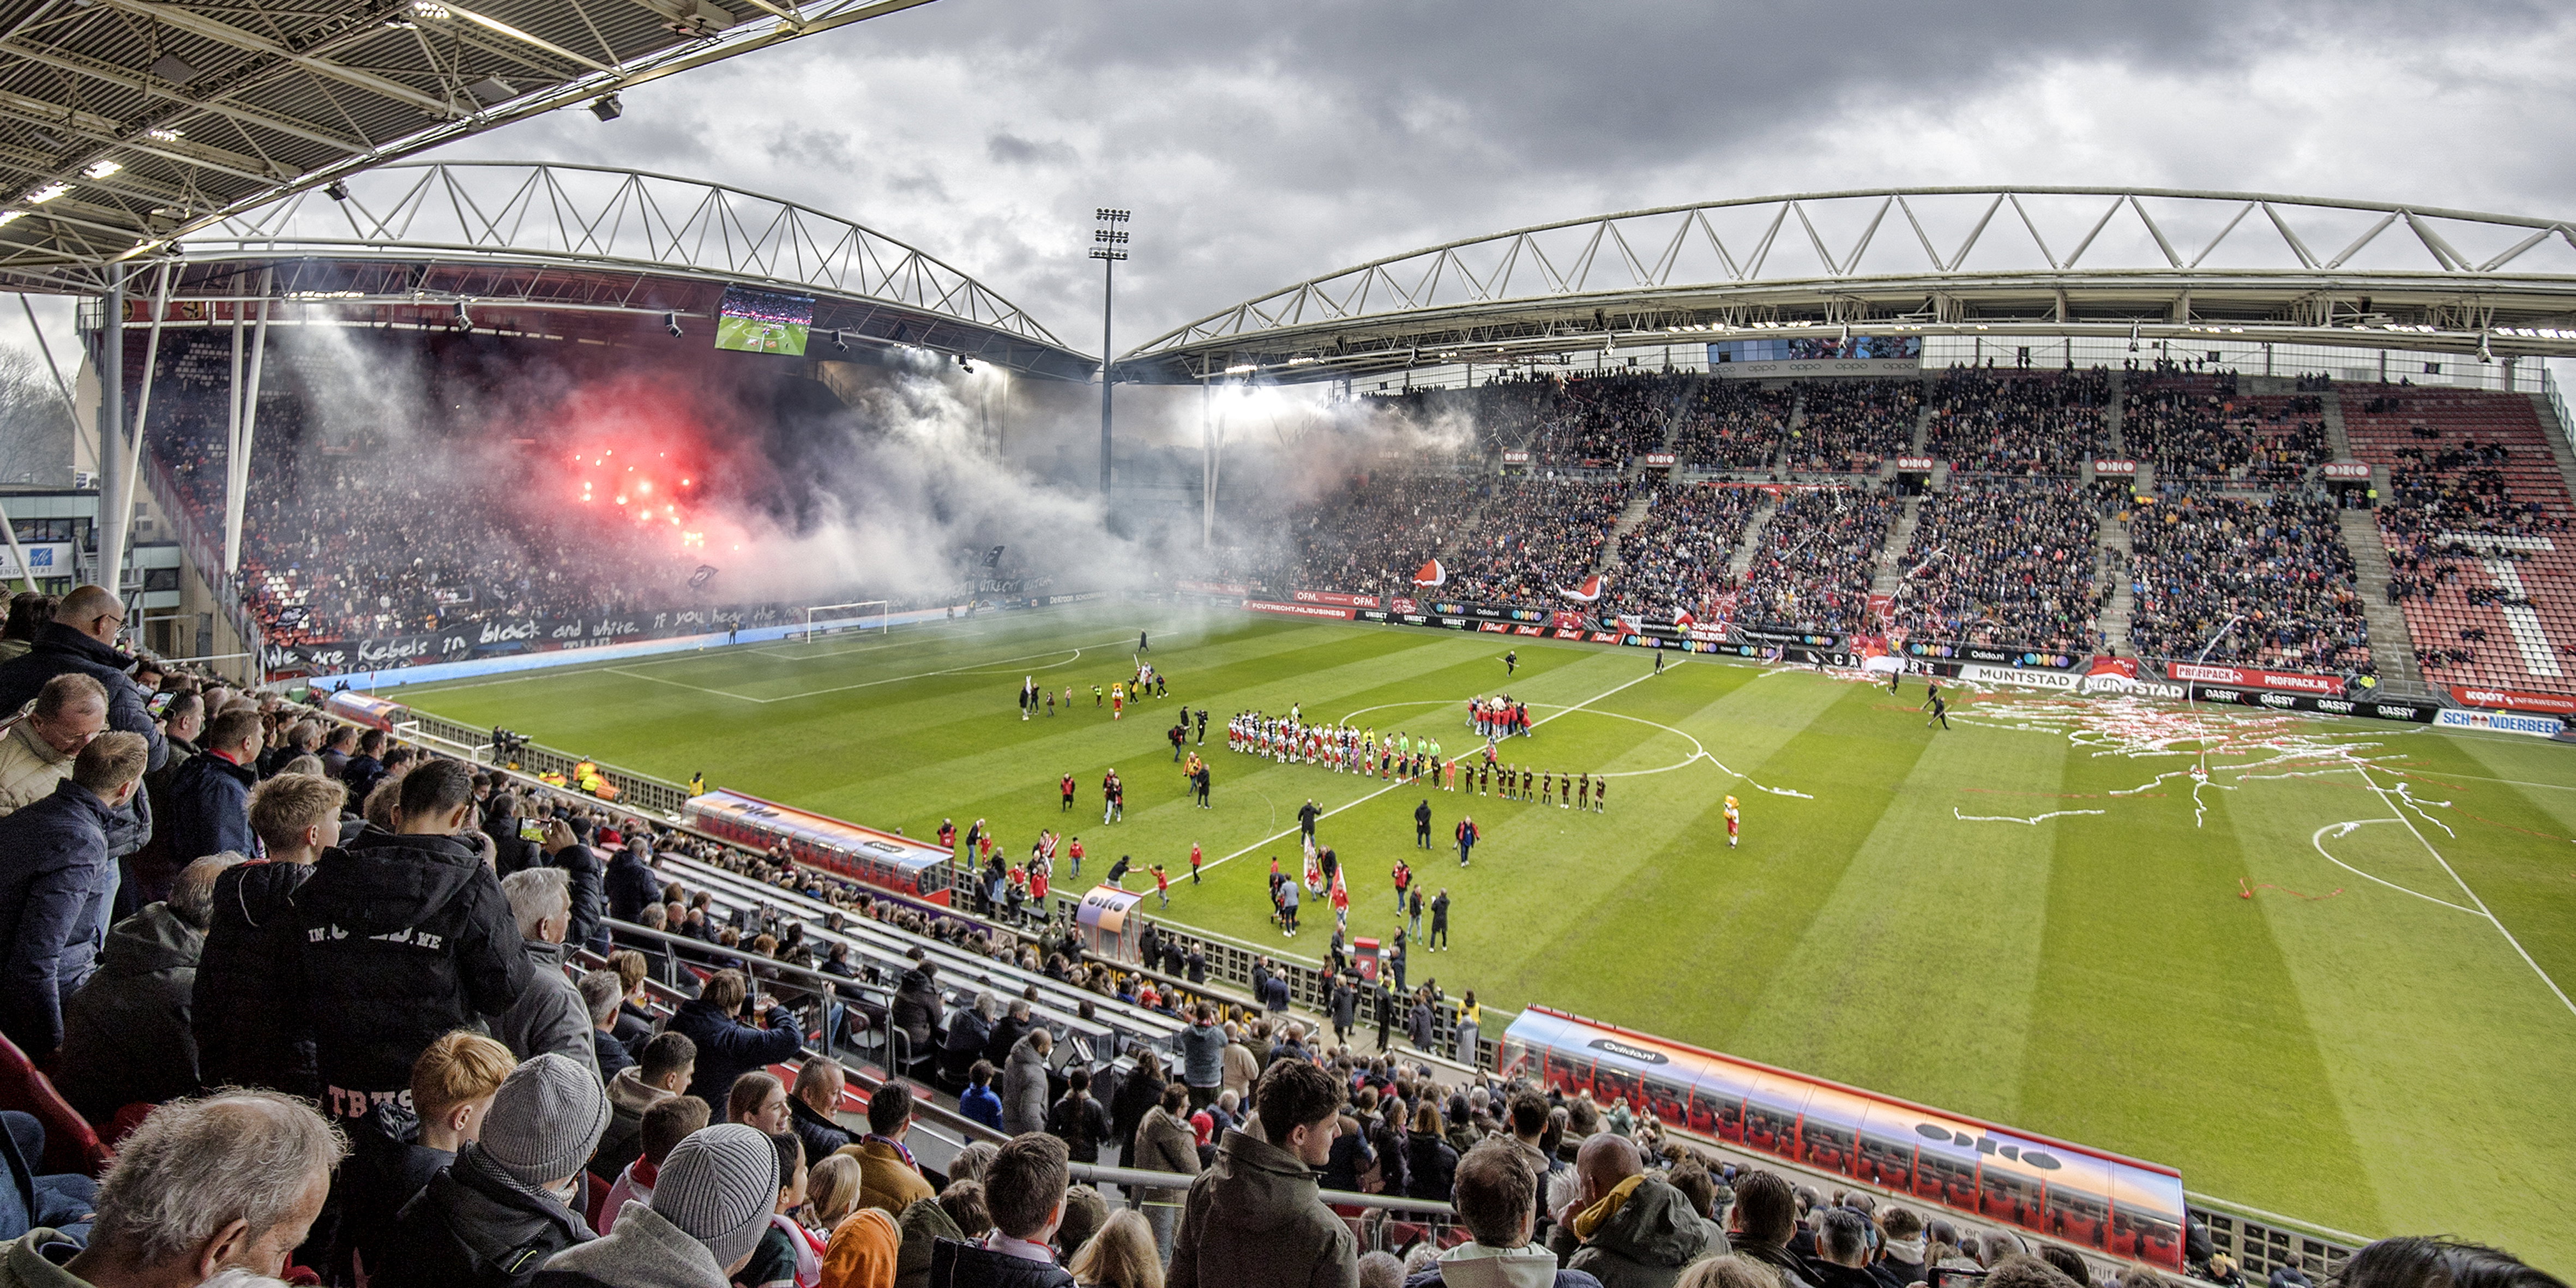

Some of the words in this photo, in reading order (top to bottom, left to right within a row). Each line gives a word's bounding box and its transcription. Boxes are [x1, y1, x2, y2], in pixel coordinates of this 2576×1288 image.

[979, 579, 1021, 593] UTRECHT
[1297, 592, 1319, 601] OFM.
[1353, 597, 1376, 606] OFM.
[1252, 603, 1346, 617] FCUTRECHT.NL/BUSINESS
[1365, 611, 1388, 619] UNIBET
[1476, 608, 1500, 616] Odido.nl
[1404, 615, 1428, 623] UNIBET
[1442, 617, 1466, 626] UNIBET
[1484, 622, 1503, 632] Bud
[1519, 625, 1538, 635] Bud
[260, 644, 299, 670] We
[311, 649, 346, 665] are
[358, 637, 429, 661] Rebels
[442, 636, 466, 654] in
[479, 619, 541, 644] black
[552, 619, 582, 639] and
[592, 618, 640, 637] white.
[674, 610, 705, 627] you
[712, 606, 744, 623] hear
[1558, 628, 1578, 639] Bud
[1595, 631, 1615, 643] Bud
[1692, 630, 1726, 641] STRIJDERS
[1971, 650, 2005, 661] Odido.nl
[1979, 668, 2069, 687] MUNTSTAD
[2264, 675, 2330, 690] PROFIPACK.NL
[2205, 688, 2240, 700] DASSY
[2260, 692, 2295, 705] DASSY
[2317, 699, 2355, 712] DASSY
[2513, 696, 2574, 708] INFRAWERKEN
[2378, 705, 2417, 718] DASSY
[1603, 1041, 1656, 1061] Odido.nl
